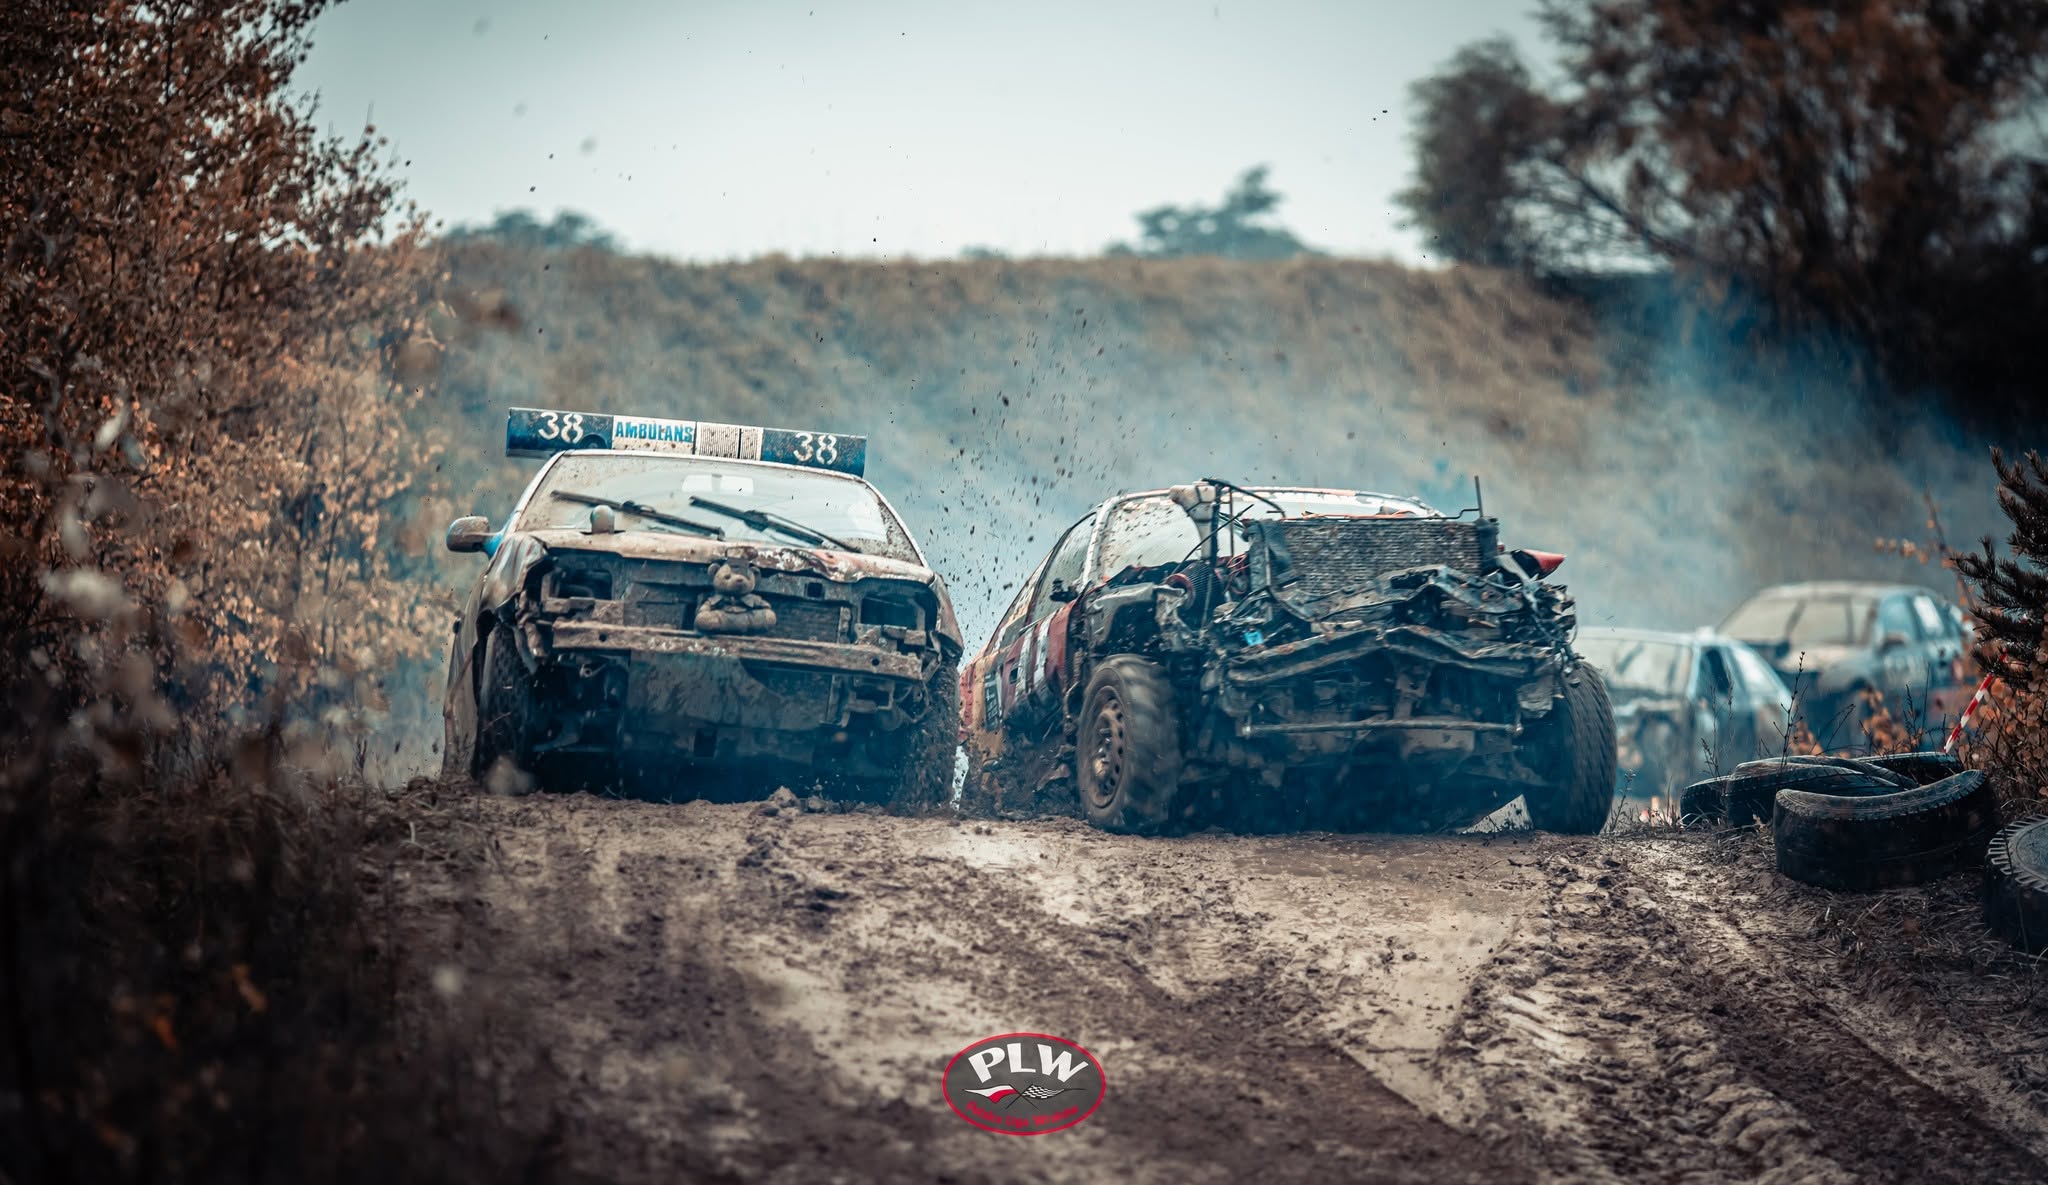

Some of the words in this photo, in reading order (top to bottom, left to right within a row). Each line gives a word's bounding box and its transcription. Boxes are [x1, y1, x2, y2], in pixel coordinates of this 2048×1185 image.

[538, 411, 584, 444] 38
[615, 421, 694, 443] AMBULANS
[793, 432, 838, 465] 38
